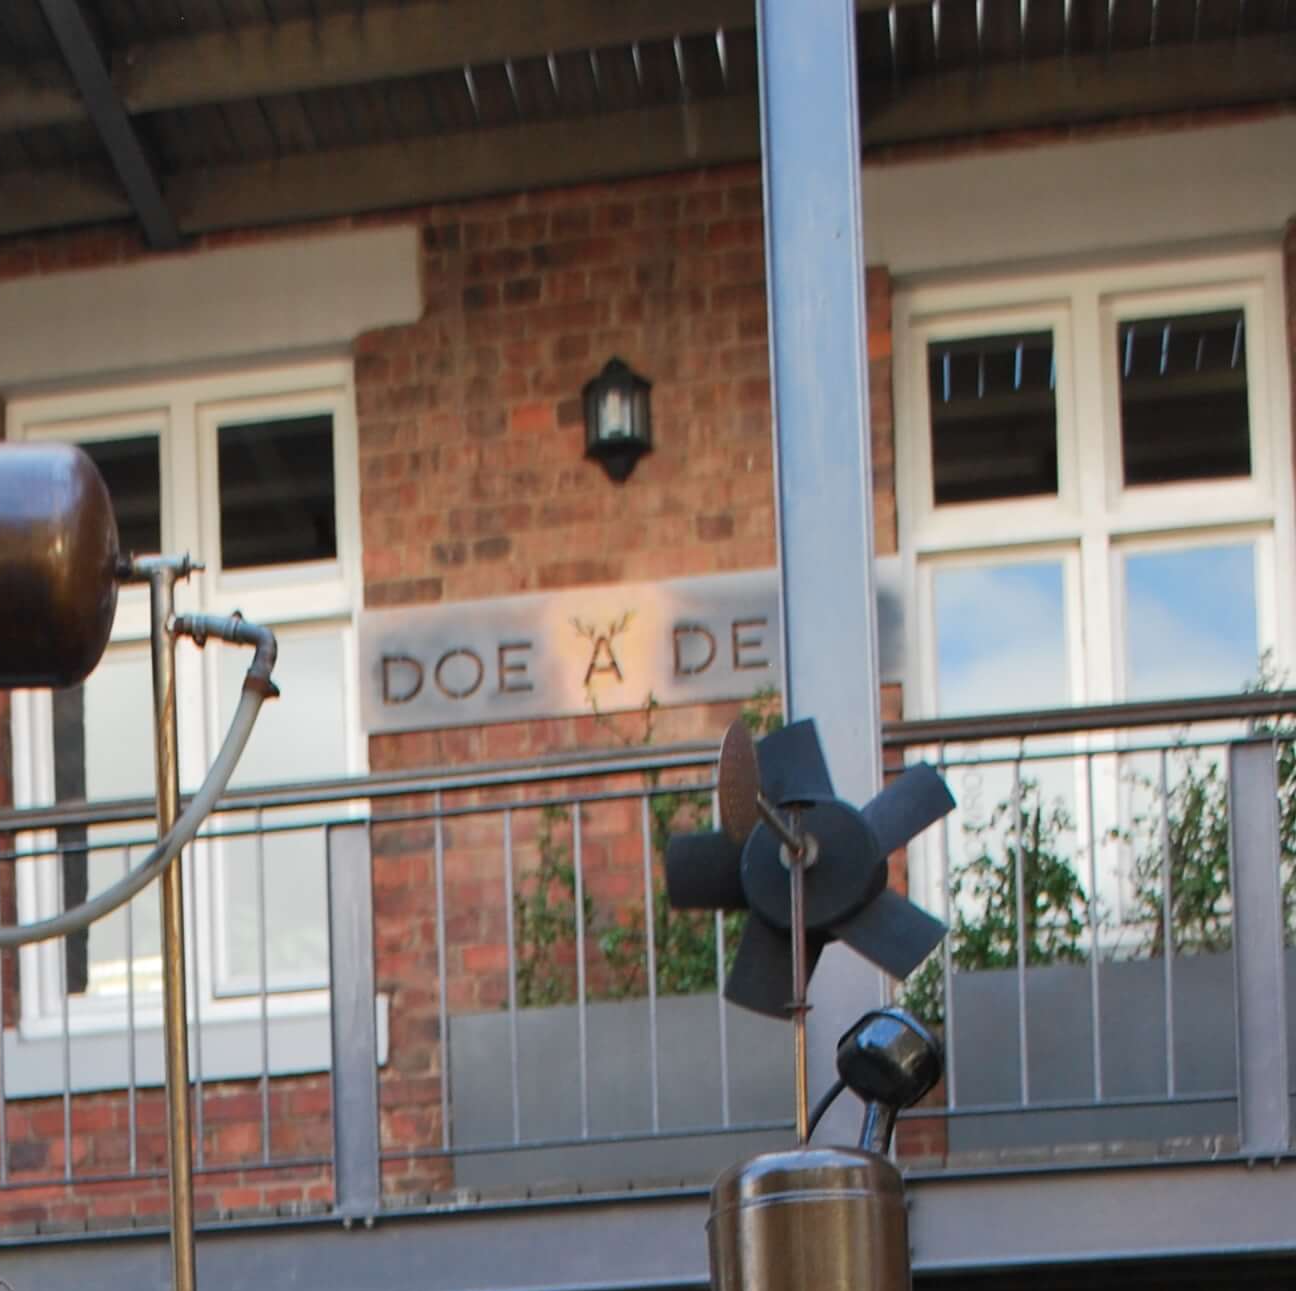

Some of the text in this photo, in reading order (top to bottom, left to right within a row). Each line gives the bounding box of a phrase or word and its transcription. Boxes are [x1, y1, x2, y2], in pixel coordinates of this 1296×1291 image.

[380, 617, 769, 706] DOE A DE
